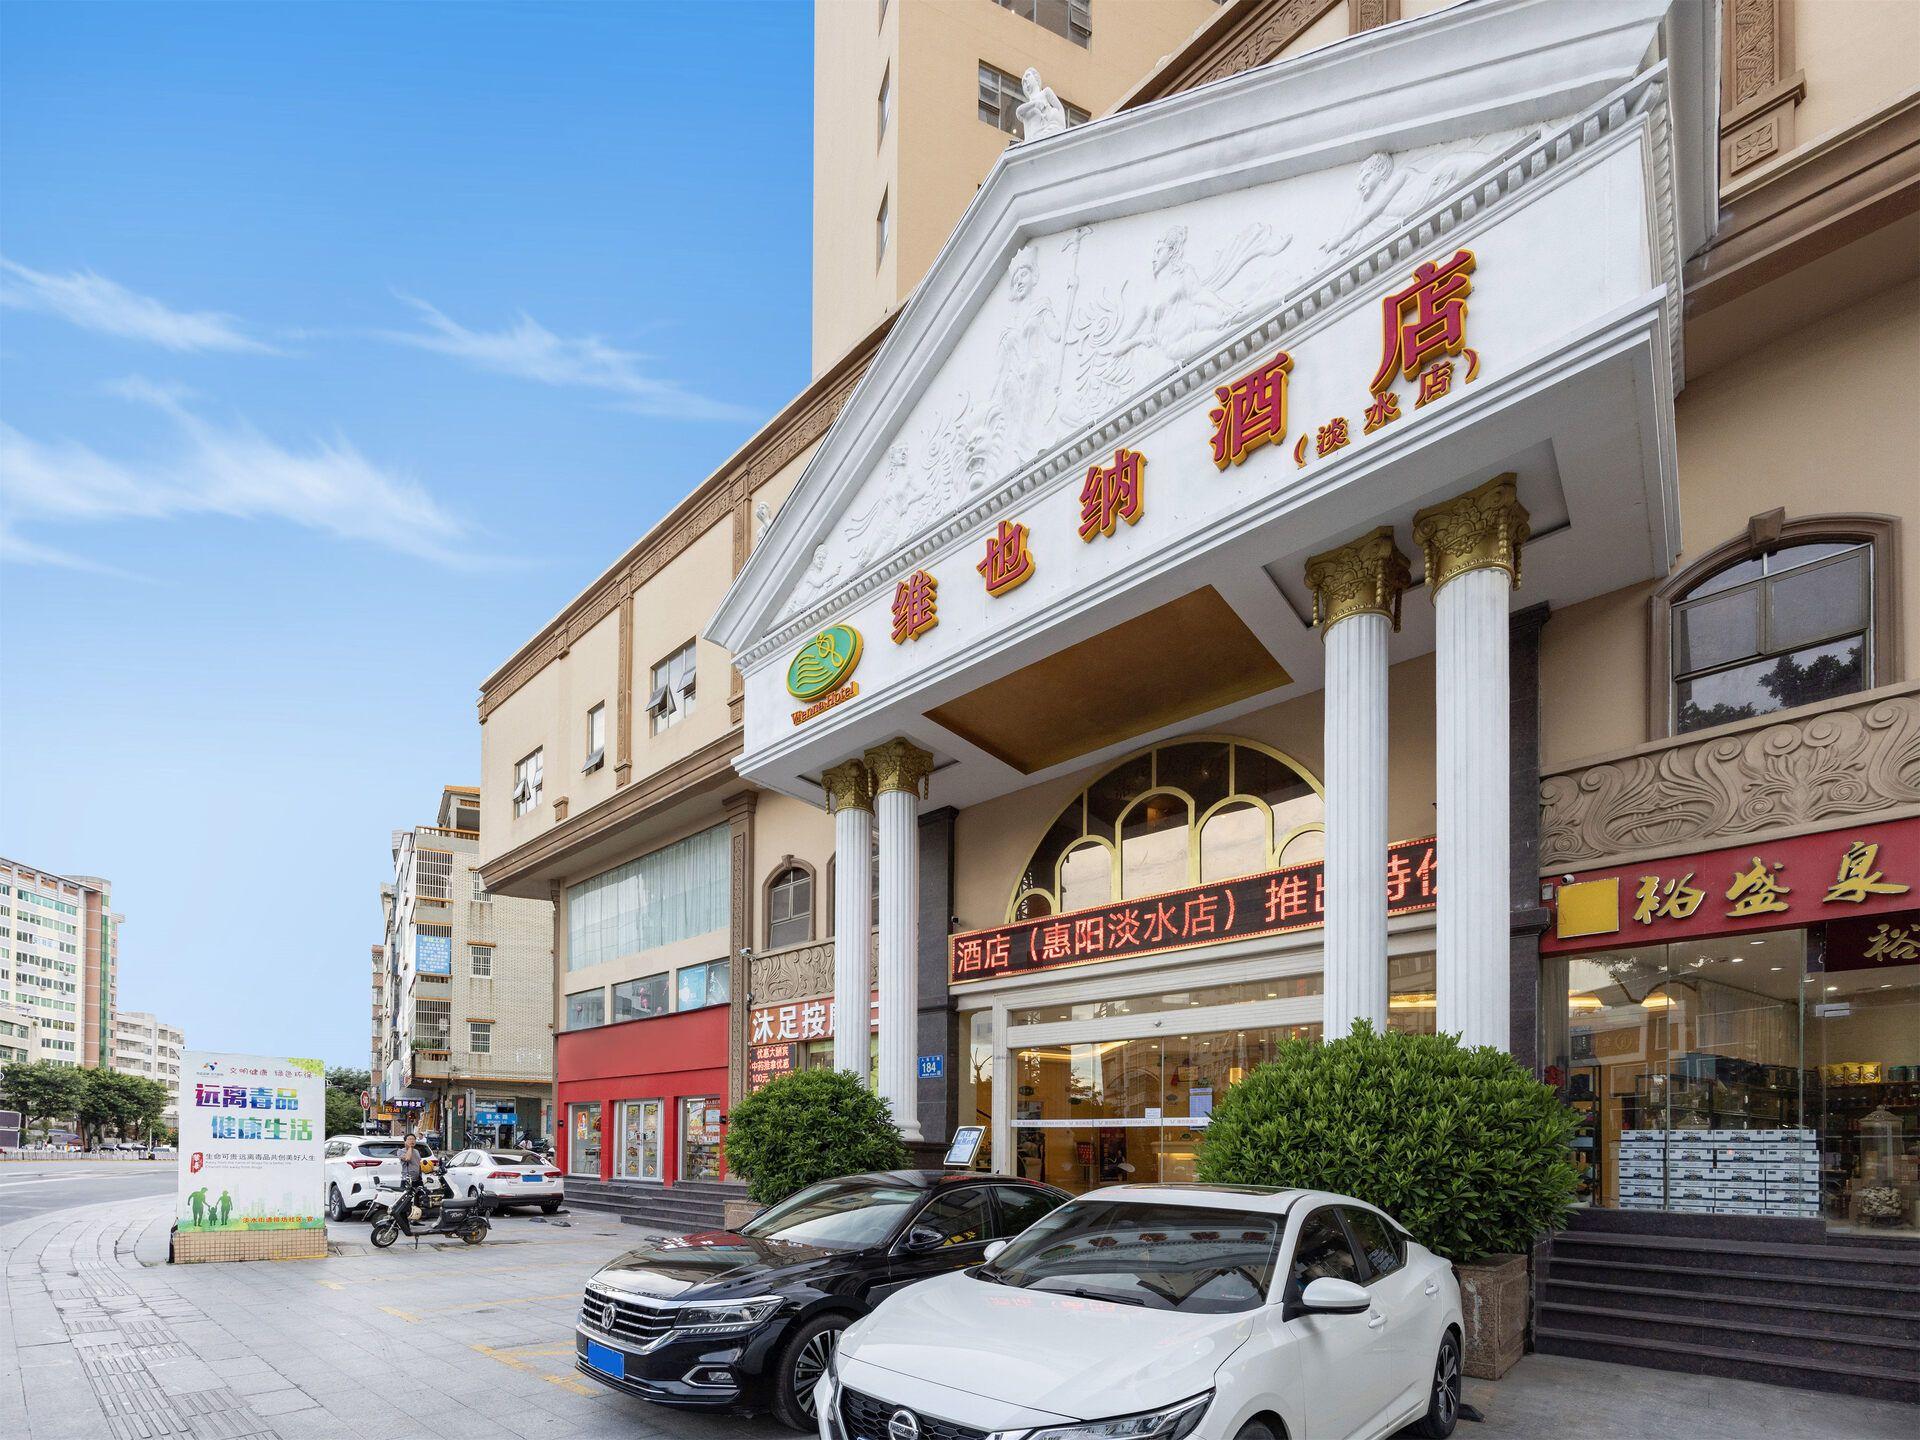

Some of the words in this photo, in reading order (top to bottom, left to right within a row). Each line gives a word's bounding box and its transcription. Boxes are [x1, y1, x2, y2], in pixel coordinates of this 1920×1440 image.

[1294, 348, 1480, 469] (淡水店)
[891, 249, 1476, 645] 维也纳酒店
[1633, 841, 1912, 925] 裕盛泉
[957, 848, 1438, 972] 酒店（惠阳淡水店）推特
[752, 1001, 836, 1043] 沐足按
[922, 1062, 936, 1073] 184
[195, 1083, 299, 1111] 远离毒品
[211, 1115, 313, 1141] 健康生活
[889, 1421, 916, 1437] NISSAN
